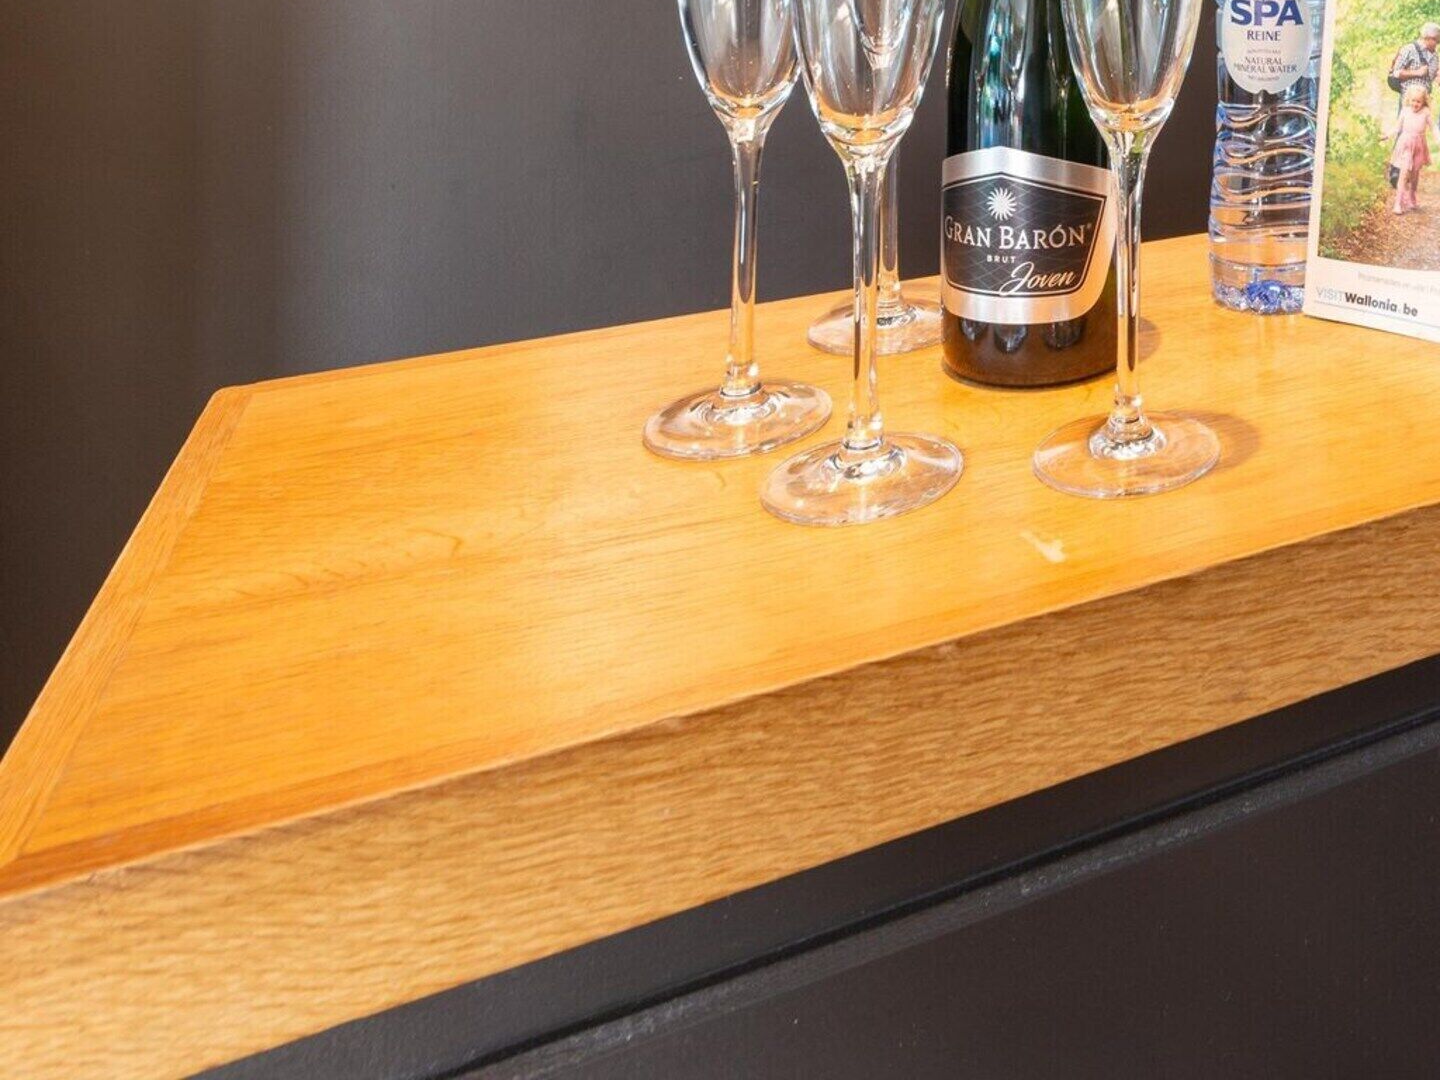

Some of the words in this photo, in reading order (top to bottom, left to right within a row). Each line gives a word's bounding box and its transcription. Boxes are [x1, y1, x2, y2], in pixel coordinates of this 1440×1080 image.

[1246, 30, 1281, 41] REINE
[1245, 56, 1283, 66] NATURAL
[1234, 63, 1266, 73] MINERAL
[1269, 63, 1298, 73] WATER
[944, 215, 991, 249] GRAN
[986, 255, 1016, 264] BRUT
[999, 261, 1076, 297] Joven
